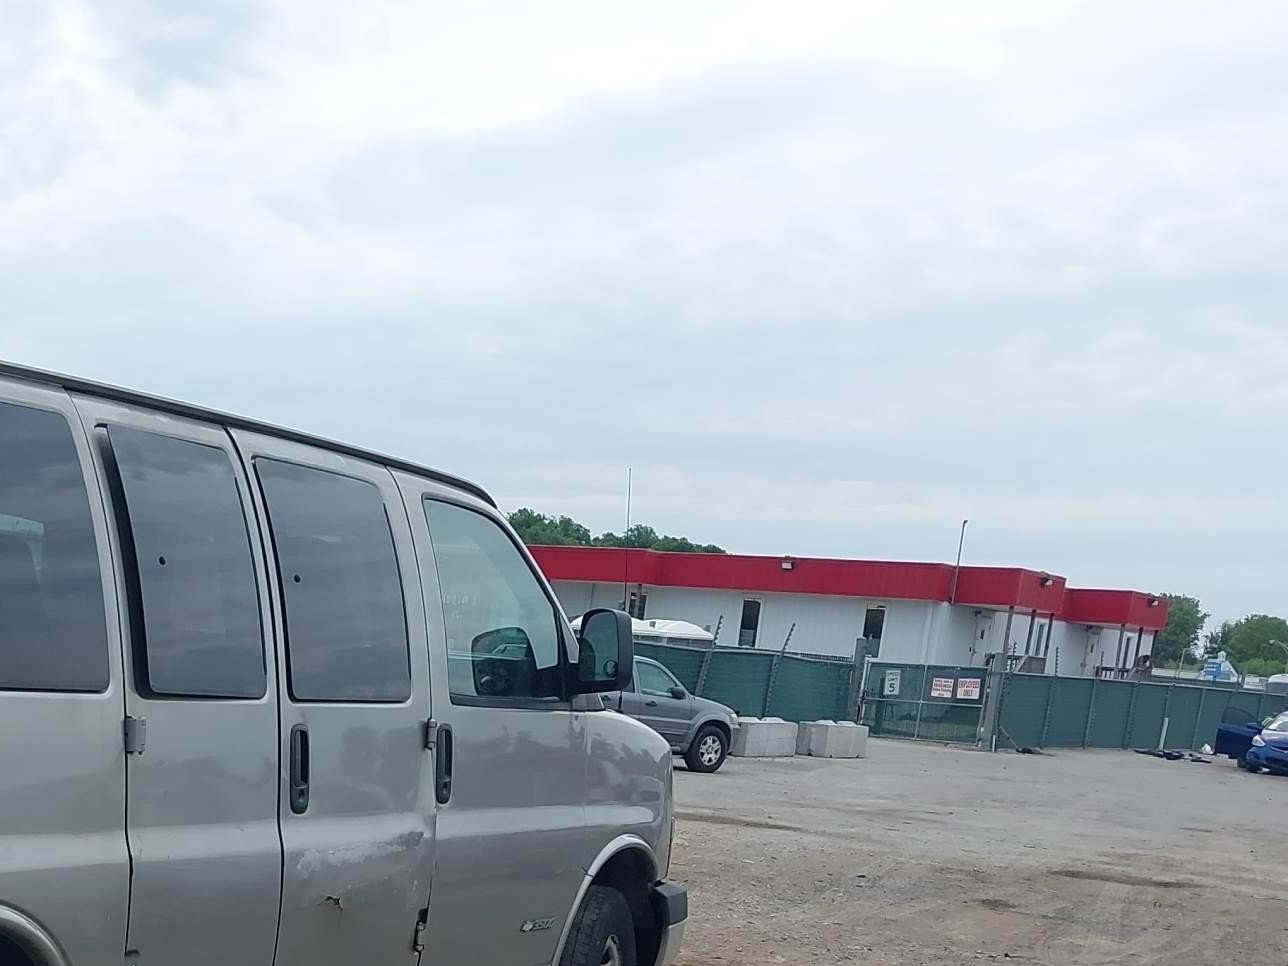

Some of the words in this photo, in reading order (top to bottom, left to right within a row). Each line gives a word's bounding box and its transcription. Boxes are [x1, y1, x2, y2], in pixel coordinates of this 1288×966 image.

[888, 682, 896, 693] 5
[958, 680, 980, 689] EMPLOYEES
[963, 688, 973, 697] ONLY
